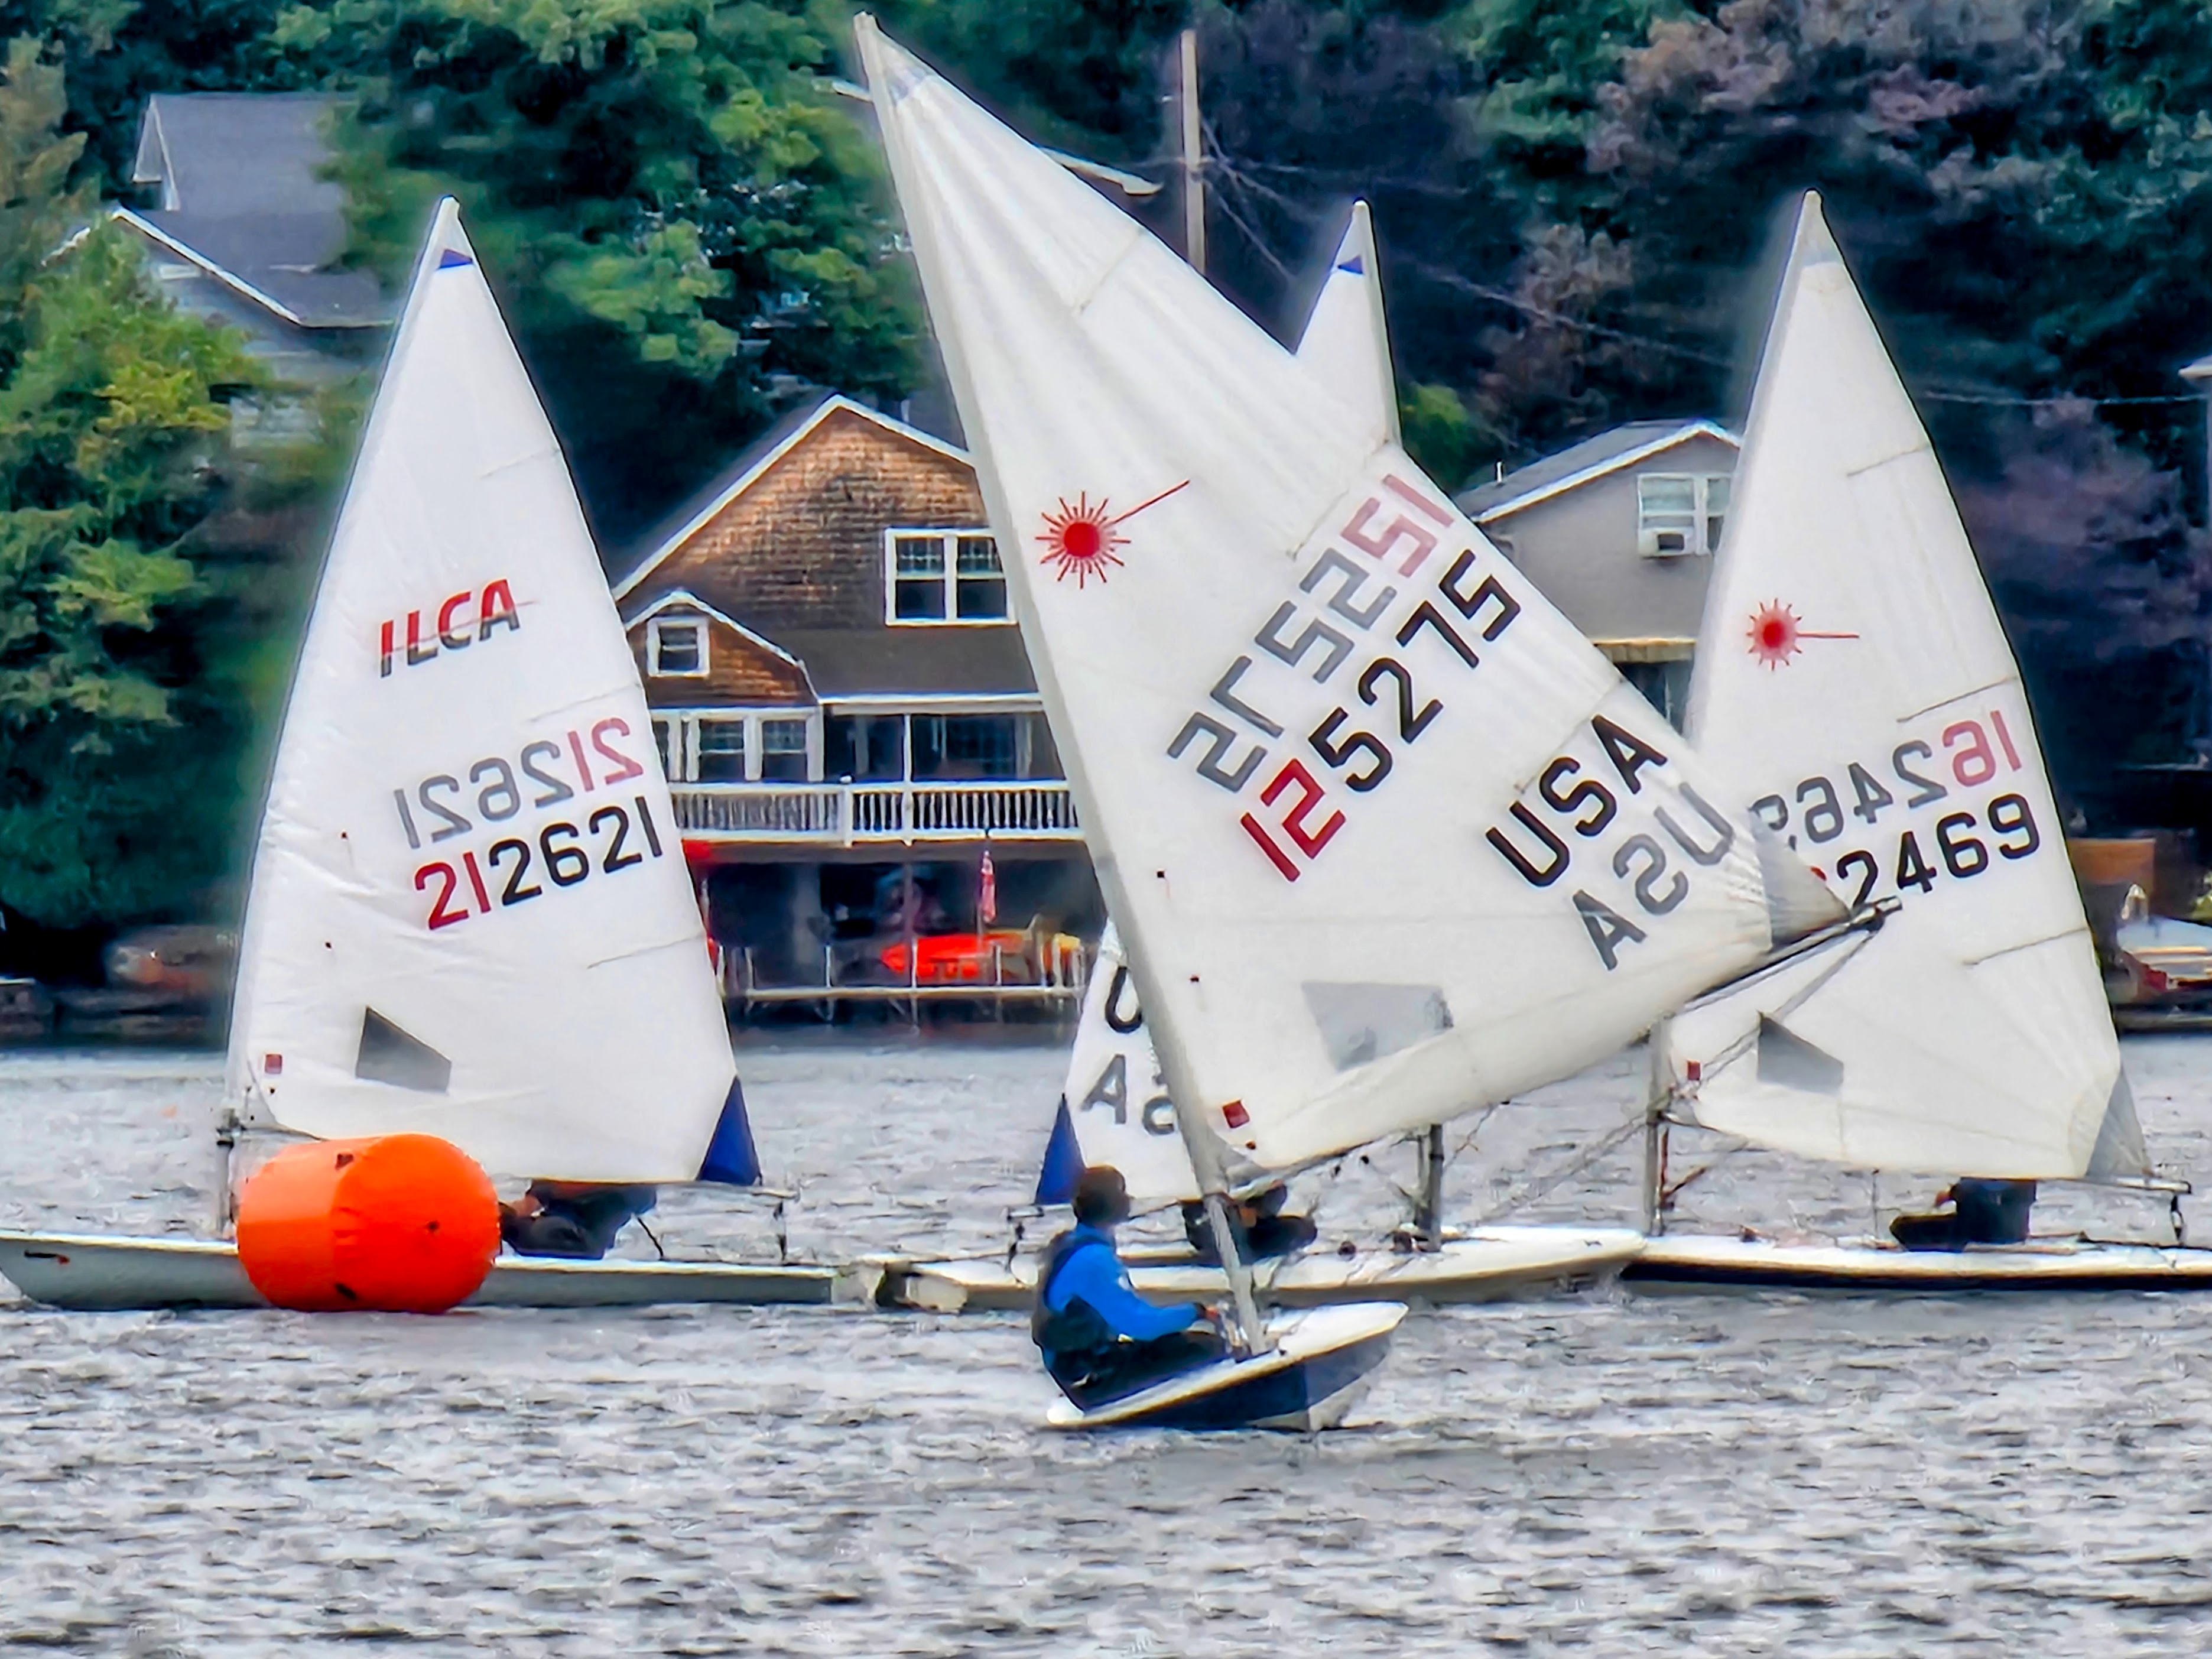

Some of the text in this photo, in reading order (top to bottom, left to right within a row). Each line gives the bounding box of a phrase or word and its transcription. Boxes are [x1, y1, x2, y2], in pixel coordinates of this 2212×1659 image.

[380, 579, 520, 678] ILCA
[1240, 548, 1521, 883] 125275
[414, 796, 663, 931] 212621
[1485, 714, 1668, 887] USA
[1810, 793, 2041, 908] 2469
